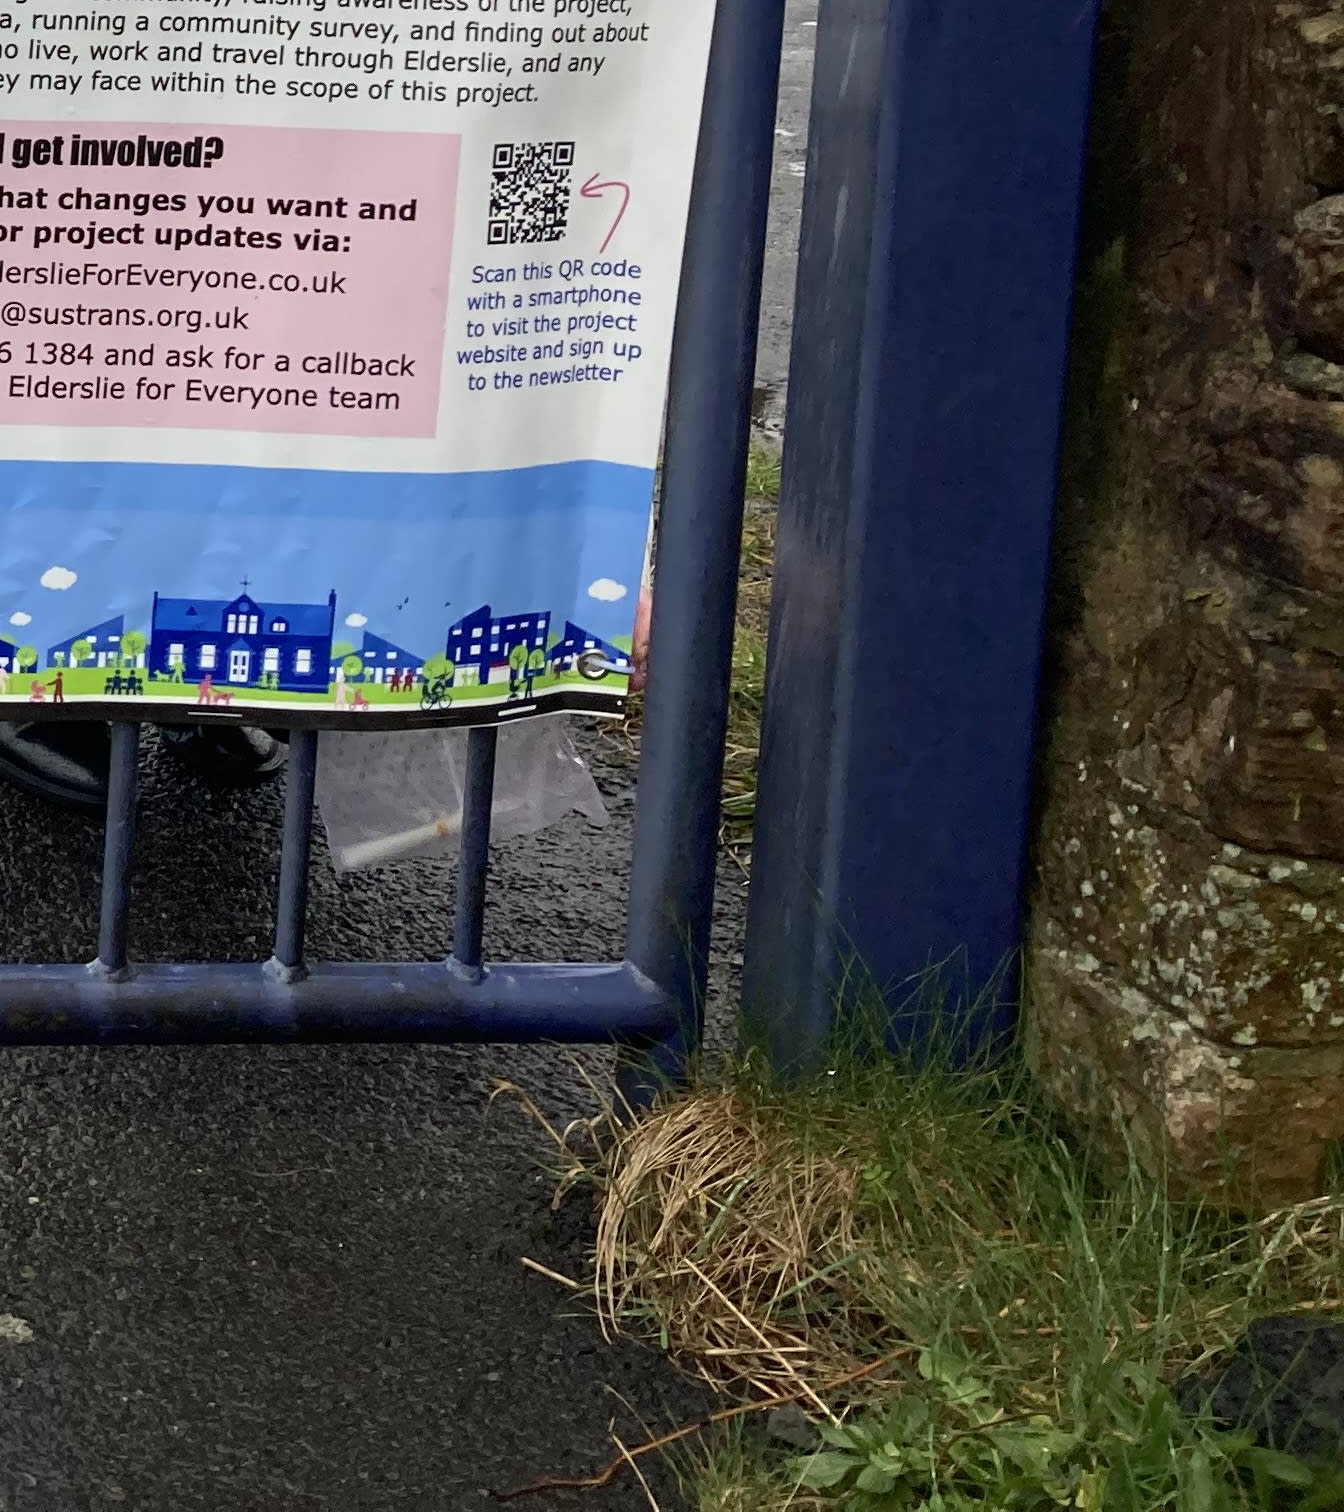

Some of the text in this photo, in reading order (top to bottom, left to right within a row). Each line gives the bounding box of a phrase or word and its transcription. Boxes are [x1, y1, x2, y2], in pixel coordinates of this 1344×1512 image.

[11, 135, 65, 169] get
[69, 133, 225, 169] involved?
[471, 258, 642, 284] Scan this QR code
[467, 284, 642, 311] with a smartphone
[466, 310, 638, 338] to visit the project
[25, 341, 95, 366] 1384
[104, 343, 155, 367] and
[165, 344, 215, 369] ask
[224, 345, 266, 371] for
[274, 354, 290, 372] a
[301, 351, 416, 377] callback
[456, 339, 642, 365] website and sign up
[468, 363, 624, 391] to the newsletter
